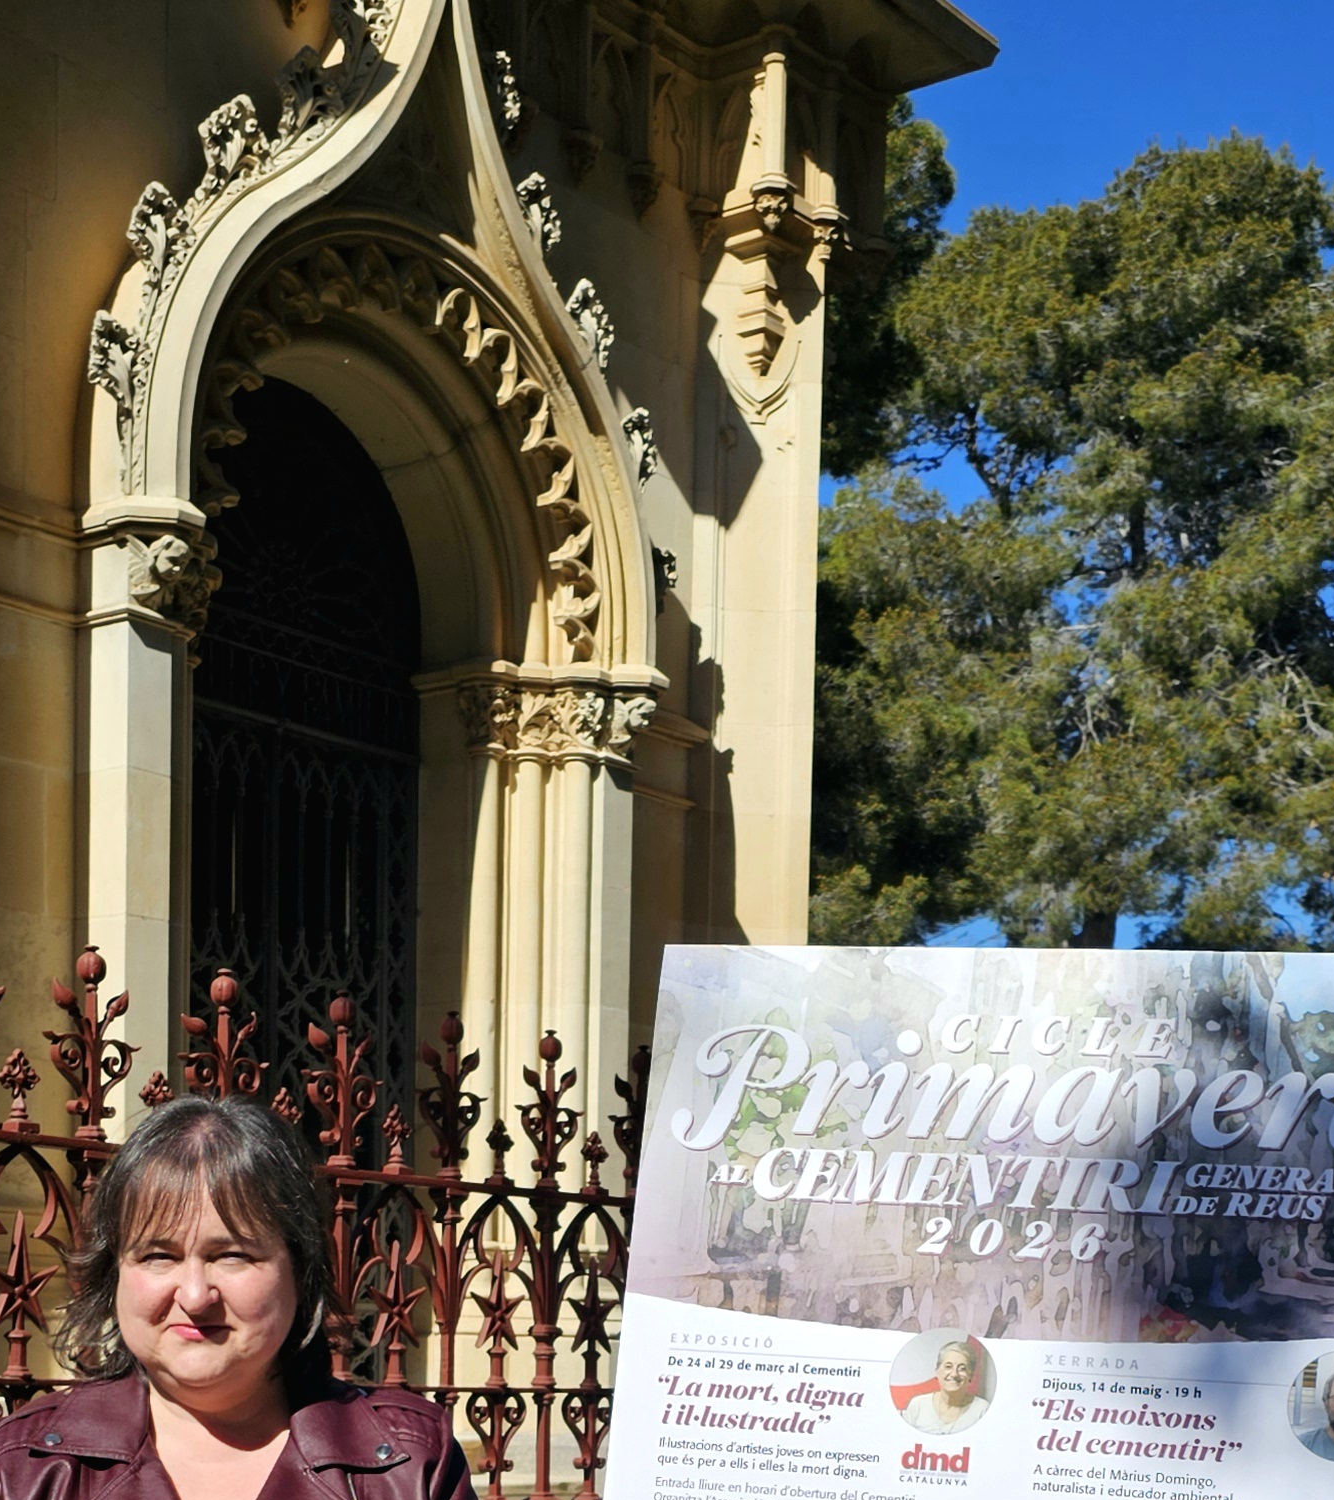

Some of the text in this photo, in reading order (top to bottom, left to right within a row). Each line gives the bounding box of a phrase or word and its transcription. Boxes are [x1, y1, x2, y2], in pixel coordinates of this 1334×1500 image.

[940, 1014, 1176, 1059] CICLE
[709, 1147, 1182, 1216] AL CEMENTIRI
[1173, 1192, 1327, 1221] DE REUS
[916, 1216, 1106, 1262] 2026
[670, 1332, 772, 1348] EXPOSICIÓ
[667, 1355, 860, 1377] De 24 al 29 de març al Cementiri
[1044, 1354, 1138, 1370] XERRADA
[706, 1383, 778, 1402] mort,
[785, 1382, 864, 1409] digna
[1042, 1378, 1201, 1398] Dijous, 14 de maig 19 h
[661, 1403, 672, 1424] i
[1090, 1403, 1216, 1430] moixons
[1036, 1428, 1082, 1452] del
[775, 1444, 804, 1458] joves
[807, 1449, 821, 1458] on
[824, 1451, 879, 1462] expressen
[901, 1443, 970, 1473] dmd
[898, 1474, 967, 1486] CATALUNYA
[1032, 1481, 1095, 1494] naturalista
[1100, 1483, 1103, 1495] i
[1107, 1484, 1166, 1499] educador
